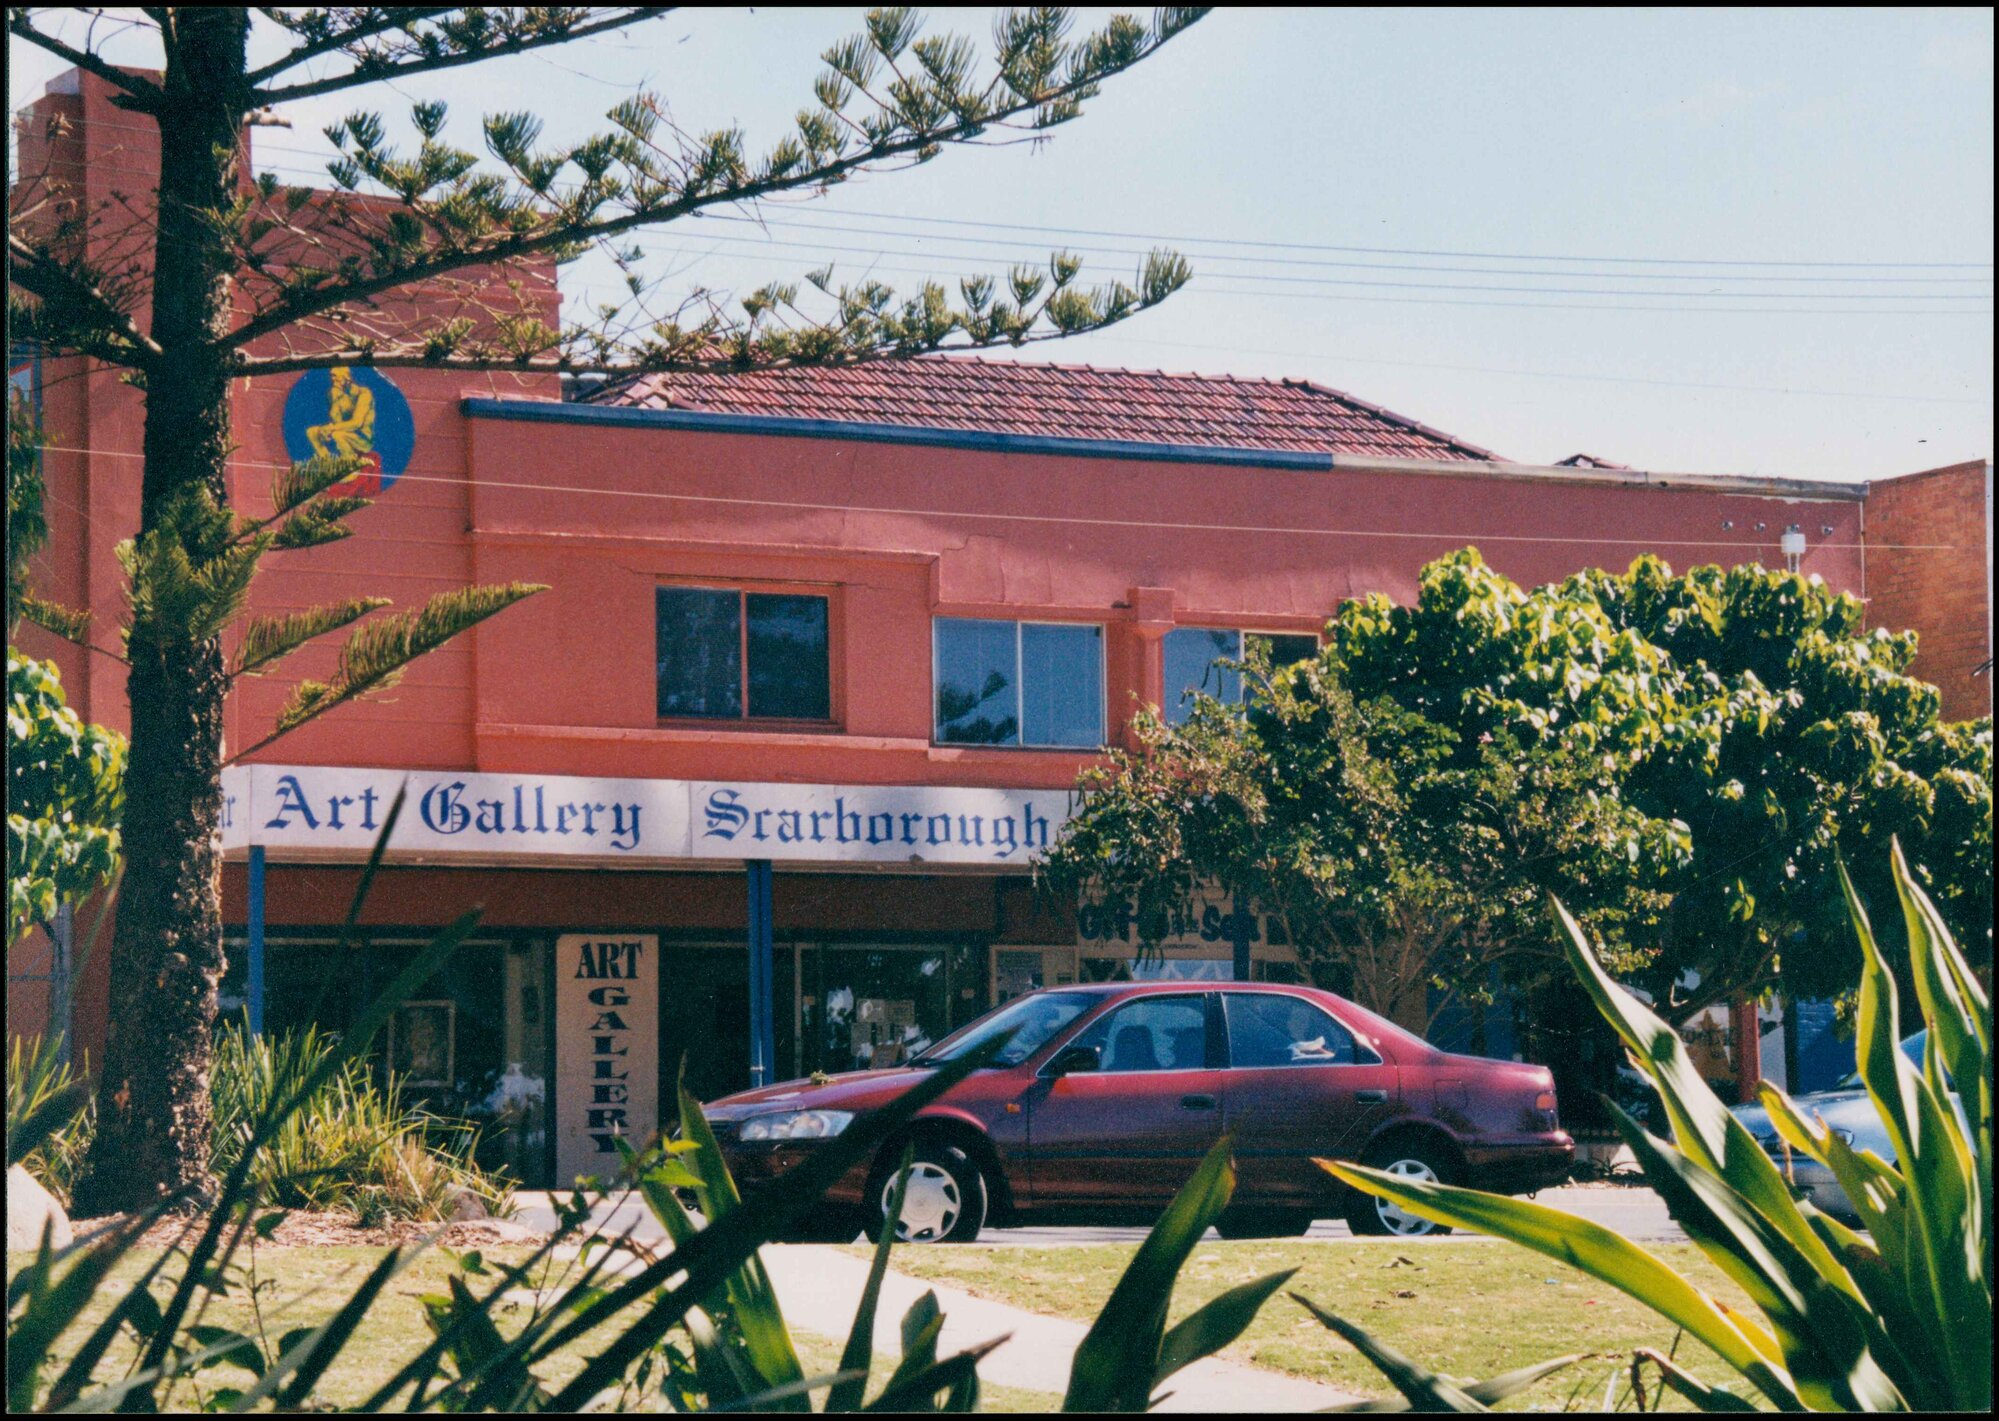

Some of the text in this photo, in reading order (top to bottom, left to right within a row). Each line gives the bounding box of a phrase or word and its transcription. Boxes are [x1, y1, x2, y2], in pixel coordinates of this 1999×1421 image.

[264, 774, 380, 832] Art
[419, 780, 643, 851] Gallery
[703, 787, 1049, 858] Scarborough
[574, 939, 643, 979] ART
